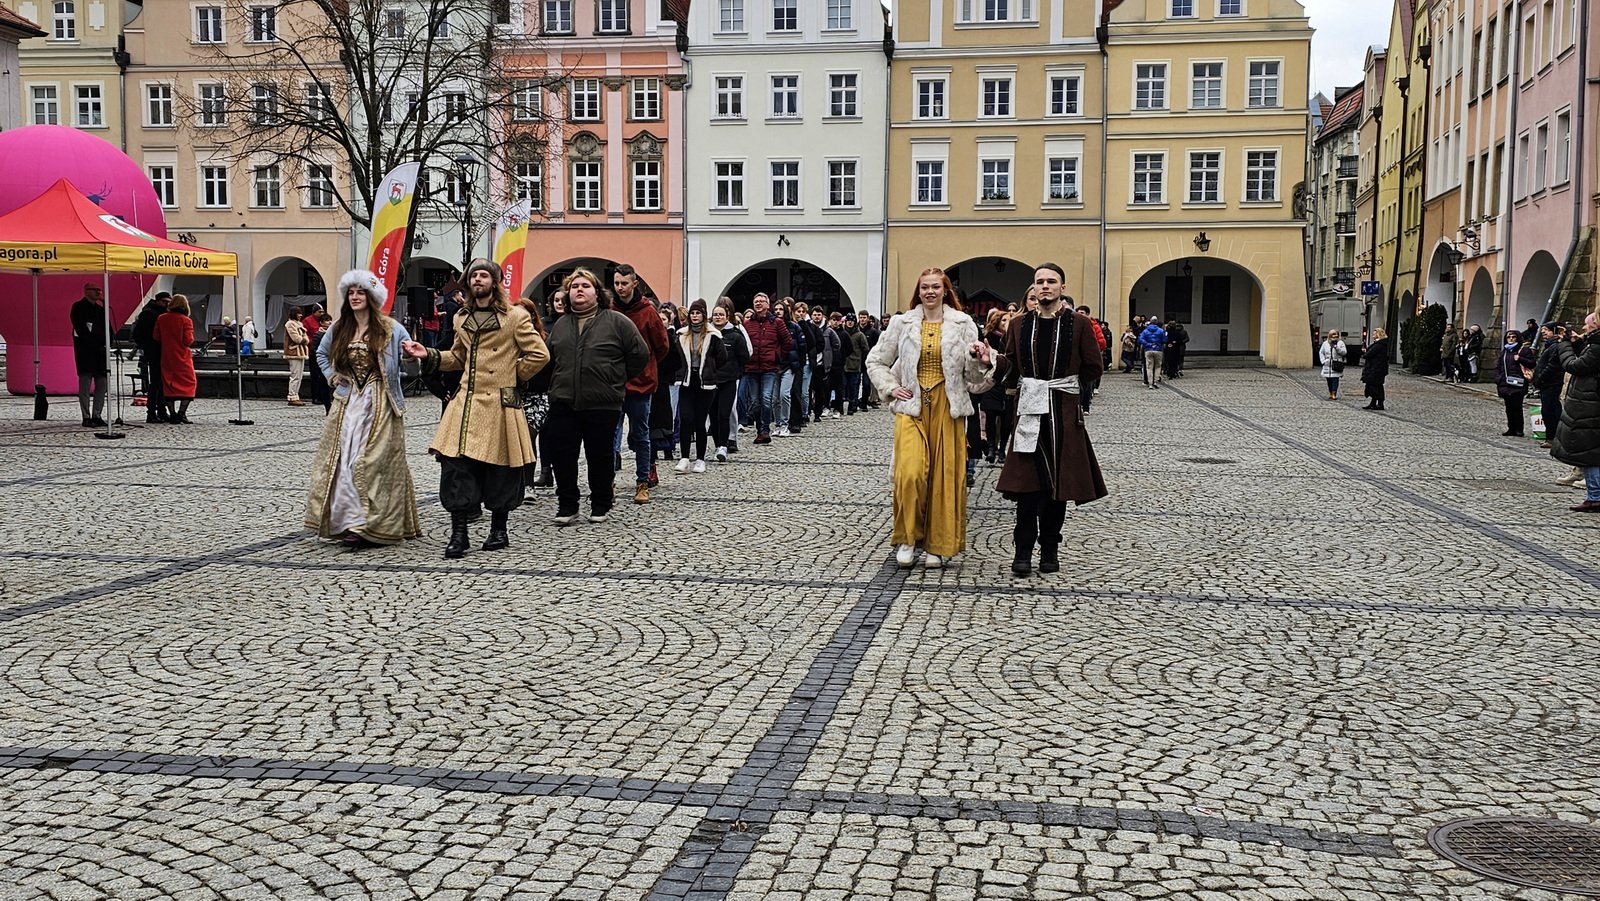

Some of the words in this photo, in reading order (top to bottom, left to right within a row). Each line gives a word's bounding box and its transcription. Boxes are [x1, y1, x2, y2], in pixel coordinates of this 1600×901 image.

[143, 250, 181, 268] Jelenia
[183, 252, 208, 269] Góra
[378, 247, 390, 276] Góra
[502, 264, 513, 287] Góra
